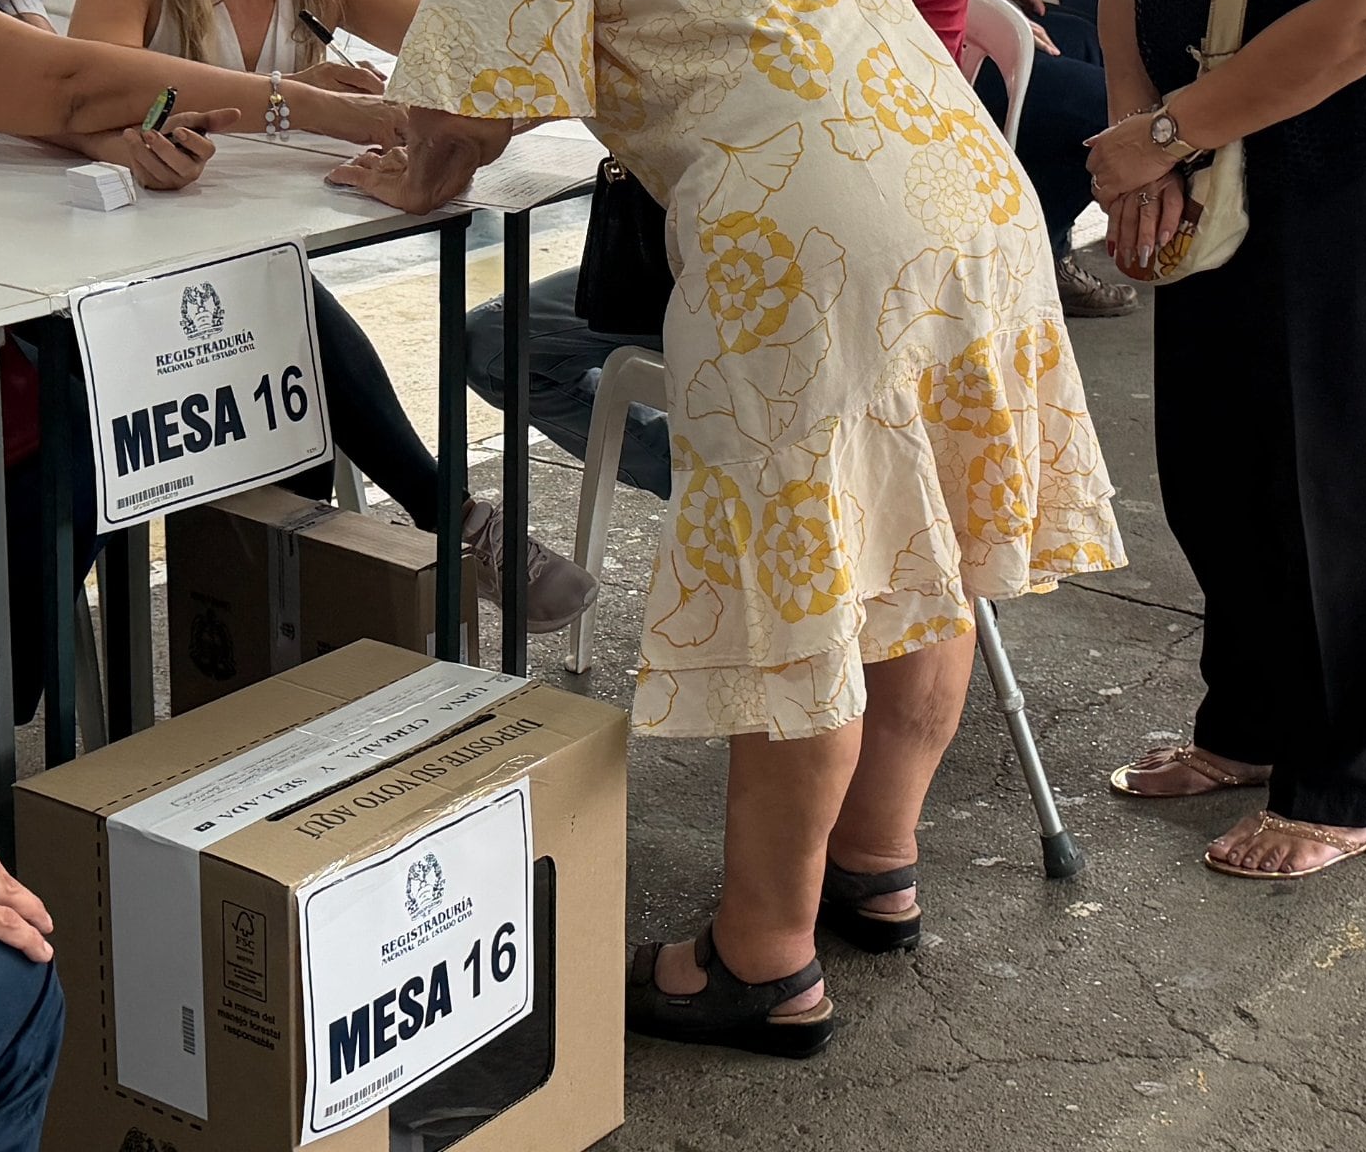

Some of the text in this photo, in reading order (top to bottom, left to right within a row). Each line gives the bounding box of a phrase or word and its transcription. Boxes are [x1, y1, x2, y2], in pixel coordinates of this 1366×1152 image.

[156, 329, 254, 367] REGISTRADURÍA
[157, 361, 193, 376] NACIONAL
[196, 357, 210, 366] DEL
[212, 349, 238, 362] ESTADO
[111, 365, 308, 477] MESA 16
[439, 687, 489, 712] URNA
[345, 718, 429, 759] CERRADA
[438, 718, 544, 767] DEPOSITE
[320, 766, 337, 775] Y
[217, 777, 308, 820] SELLADA
[294, 805, 357, 840] AQUÍ
[236, 935, 255, 949] FSC
[381, 896, 473, 956] REGISTRADURÍA
[328, 921, 516, 1085] MESA 16
